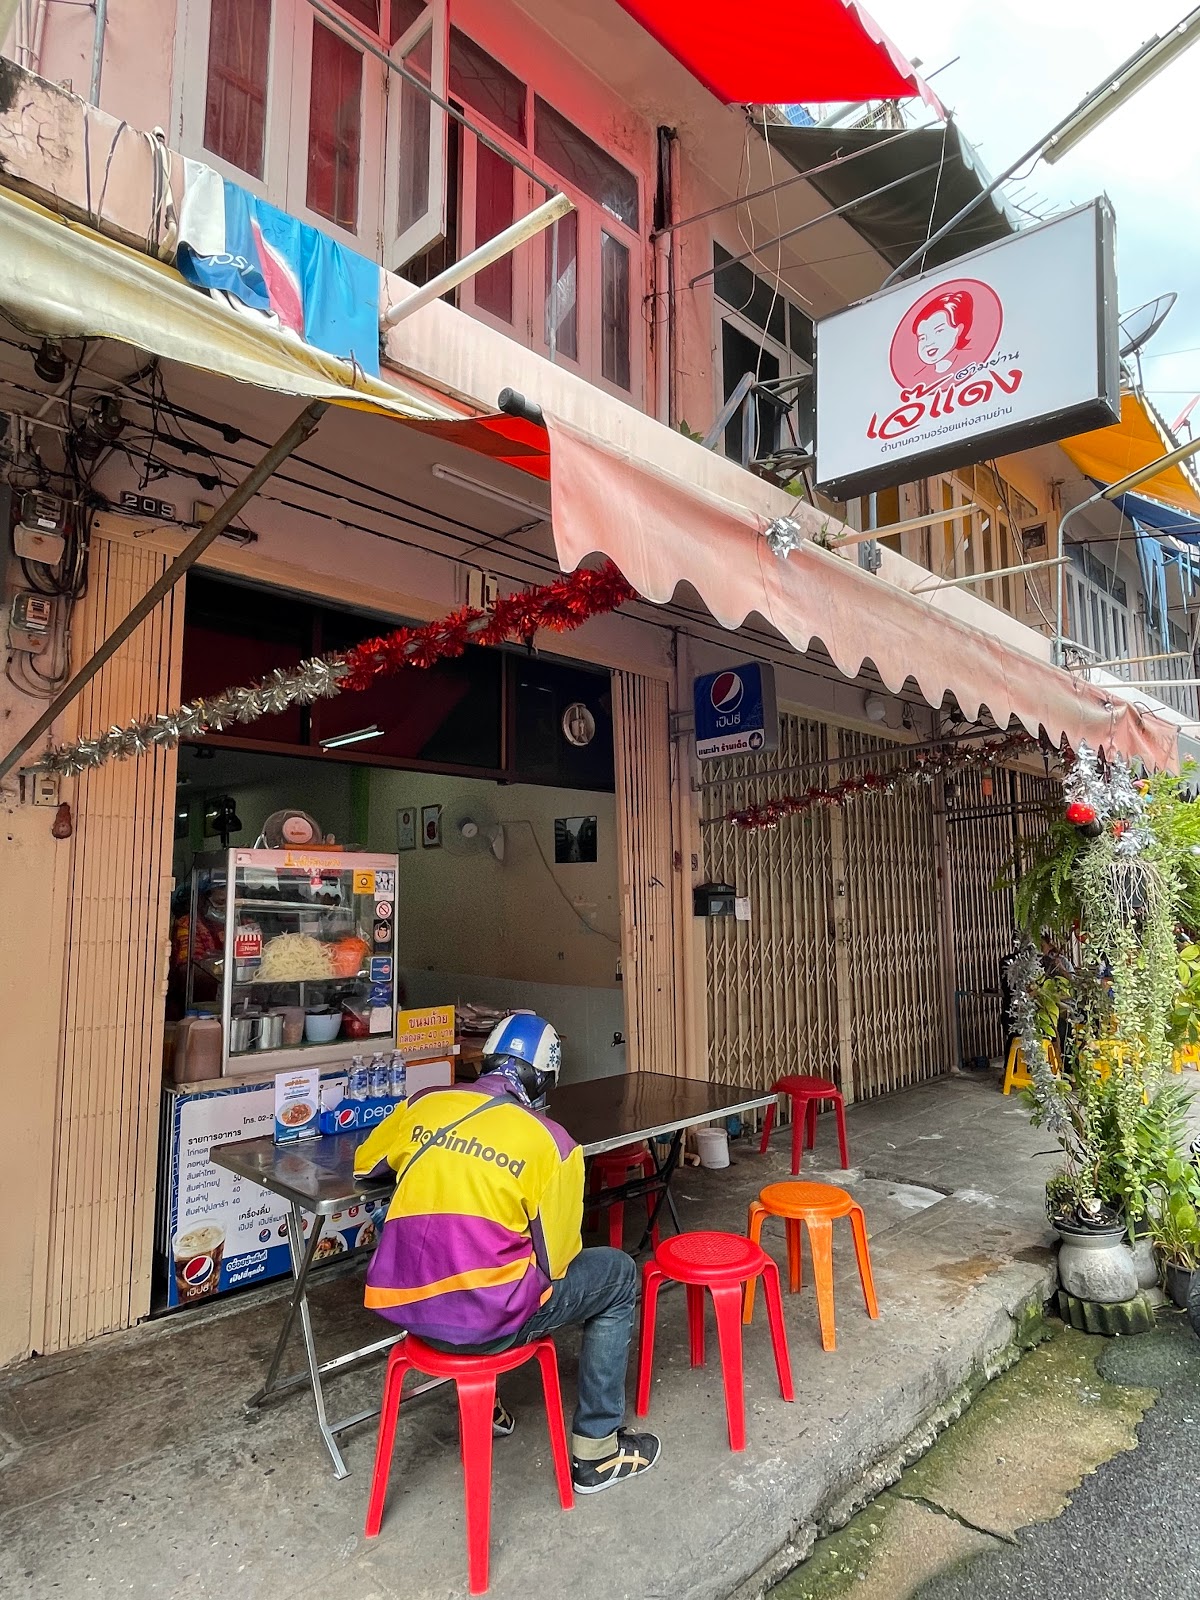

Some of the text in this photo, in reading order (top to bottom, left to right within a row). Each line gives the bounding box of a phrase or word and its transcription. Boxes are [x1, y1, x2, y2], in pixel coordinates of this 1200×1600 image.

[955, 350, 1020, 381] สามย่าน
[866, 368, 1024, 440] เจ๊แดง
[880, 405, 1013, 453] ตำนานความอร่อยแห่งสามย่าน
[124, 493, 176, 519] 209
[408, 1010, 448, 1029] ขนมถ้วย
[428, 1031, 438, 1039] 40
[187, 1129, 242, 1146] รายการอาหาร
[410, 1125, 527, 1179] Robinhood
[231, 1197, 241, 1205] 40
